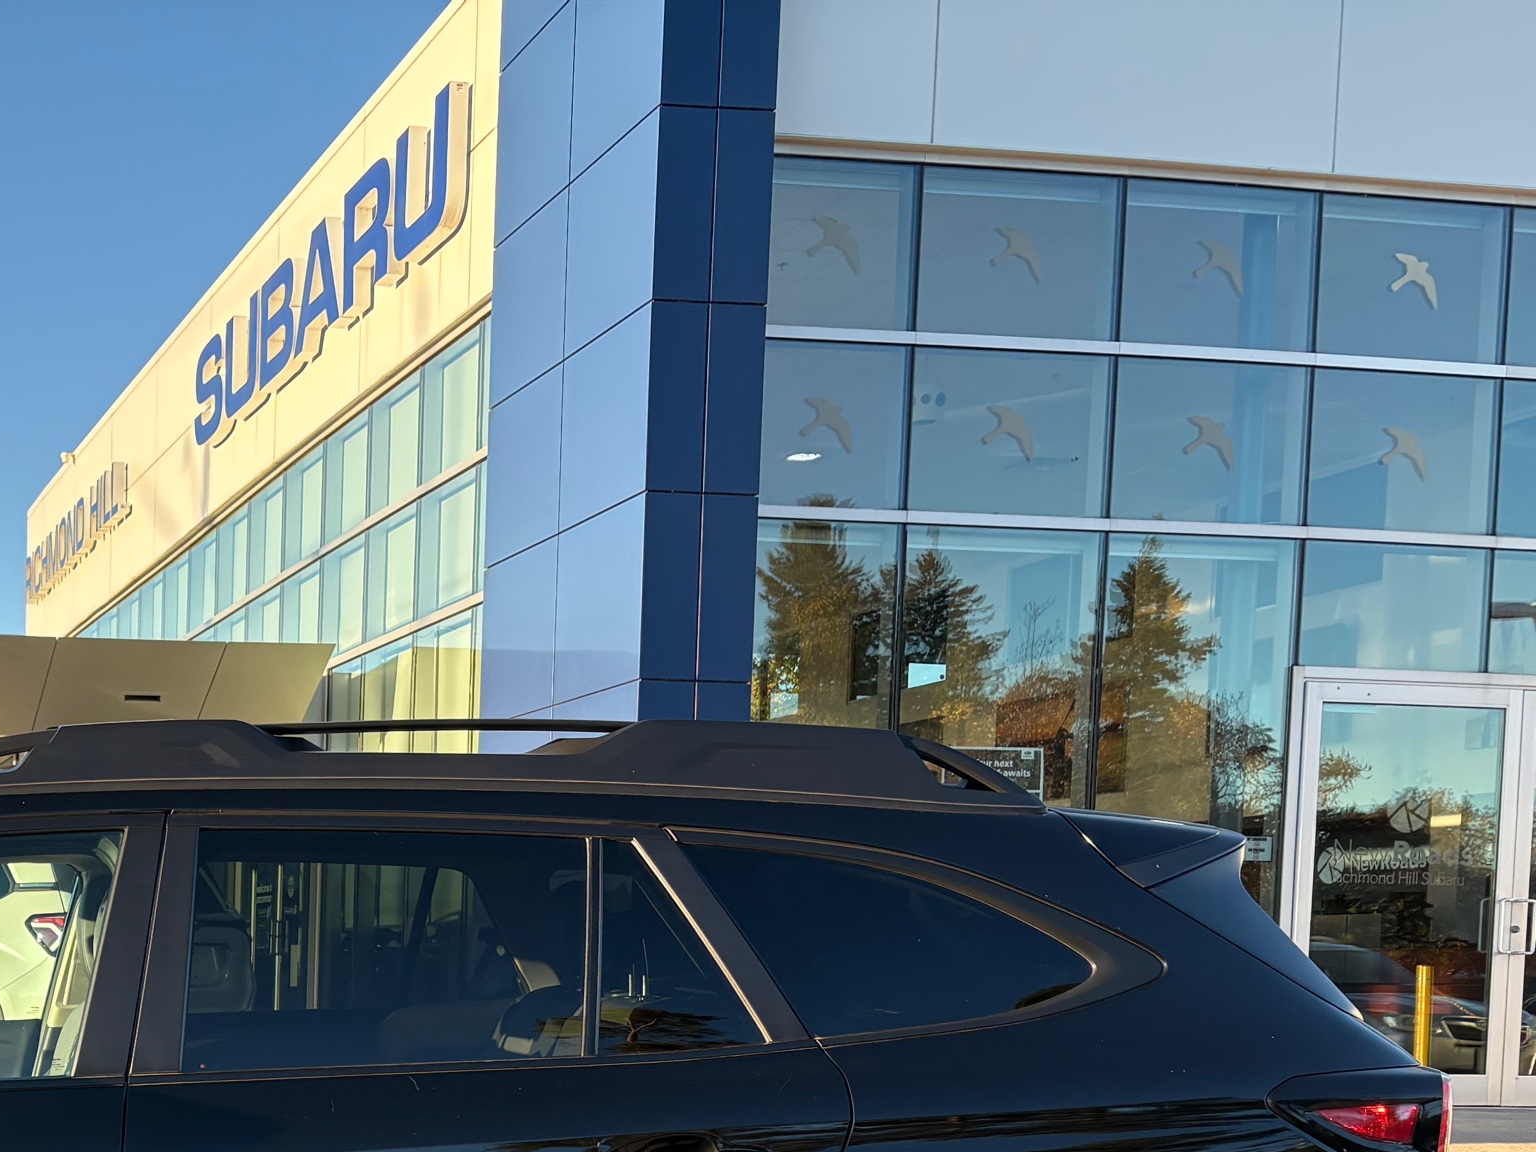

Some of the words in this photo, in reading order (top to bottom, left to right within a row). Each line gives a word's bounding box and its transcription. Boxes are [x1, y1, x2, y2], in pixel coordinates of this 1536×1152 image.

[194, 82, 468, 446] SUBARU
[90, 462, 125, 539] HILL
[1398, 870, 1419, 885] Hill
[1421, 871, 1465, 887] Subaru
